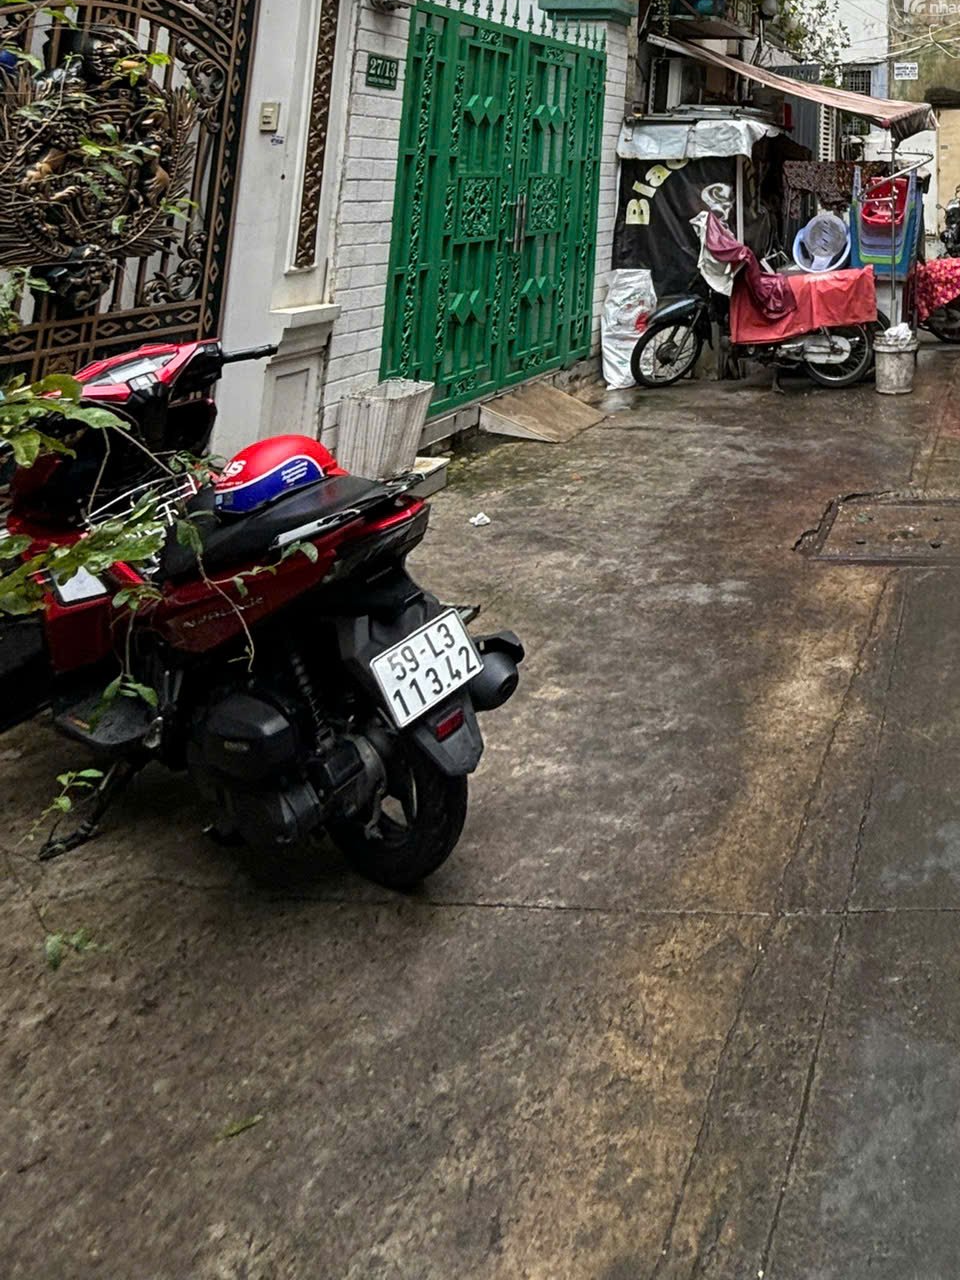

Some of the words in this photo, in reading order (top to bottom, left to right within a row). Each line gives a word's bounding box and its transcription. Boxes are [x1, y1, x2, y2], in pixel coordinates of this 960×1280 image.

[369, 58, 397, 78] 27/13
[387, 623, 455, 681] 59-L3
[393, 645, 477, 717] 113.42
